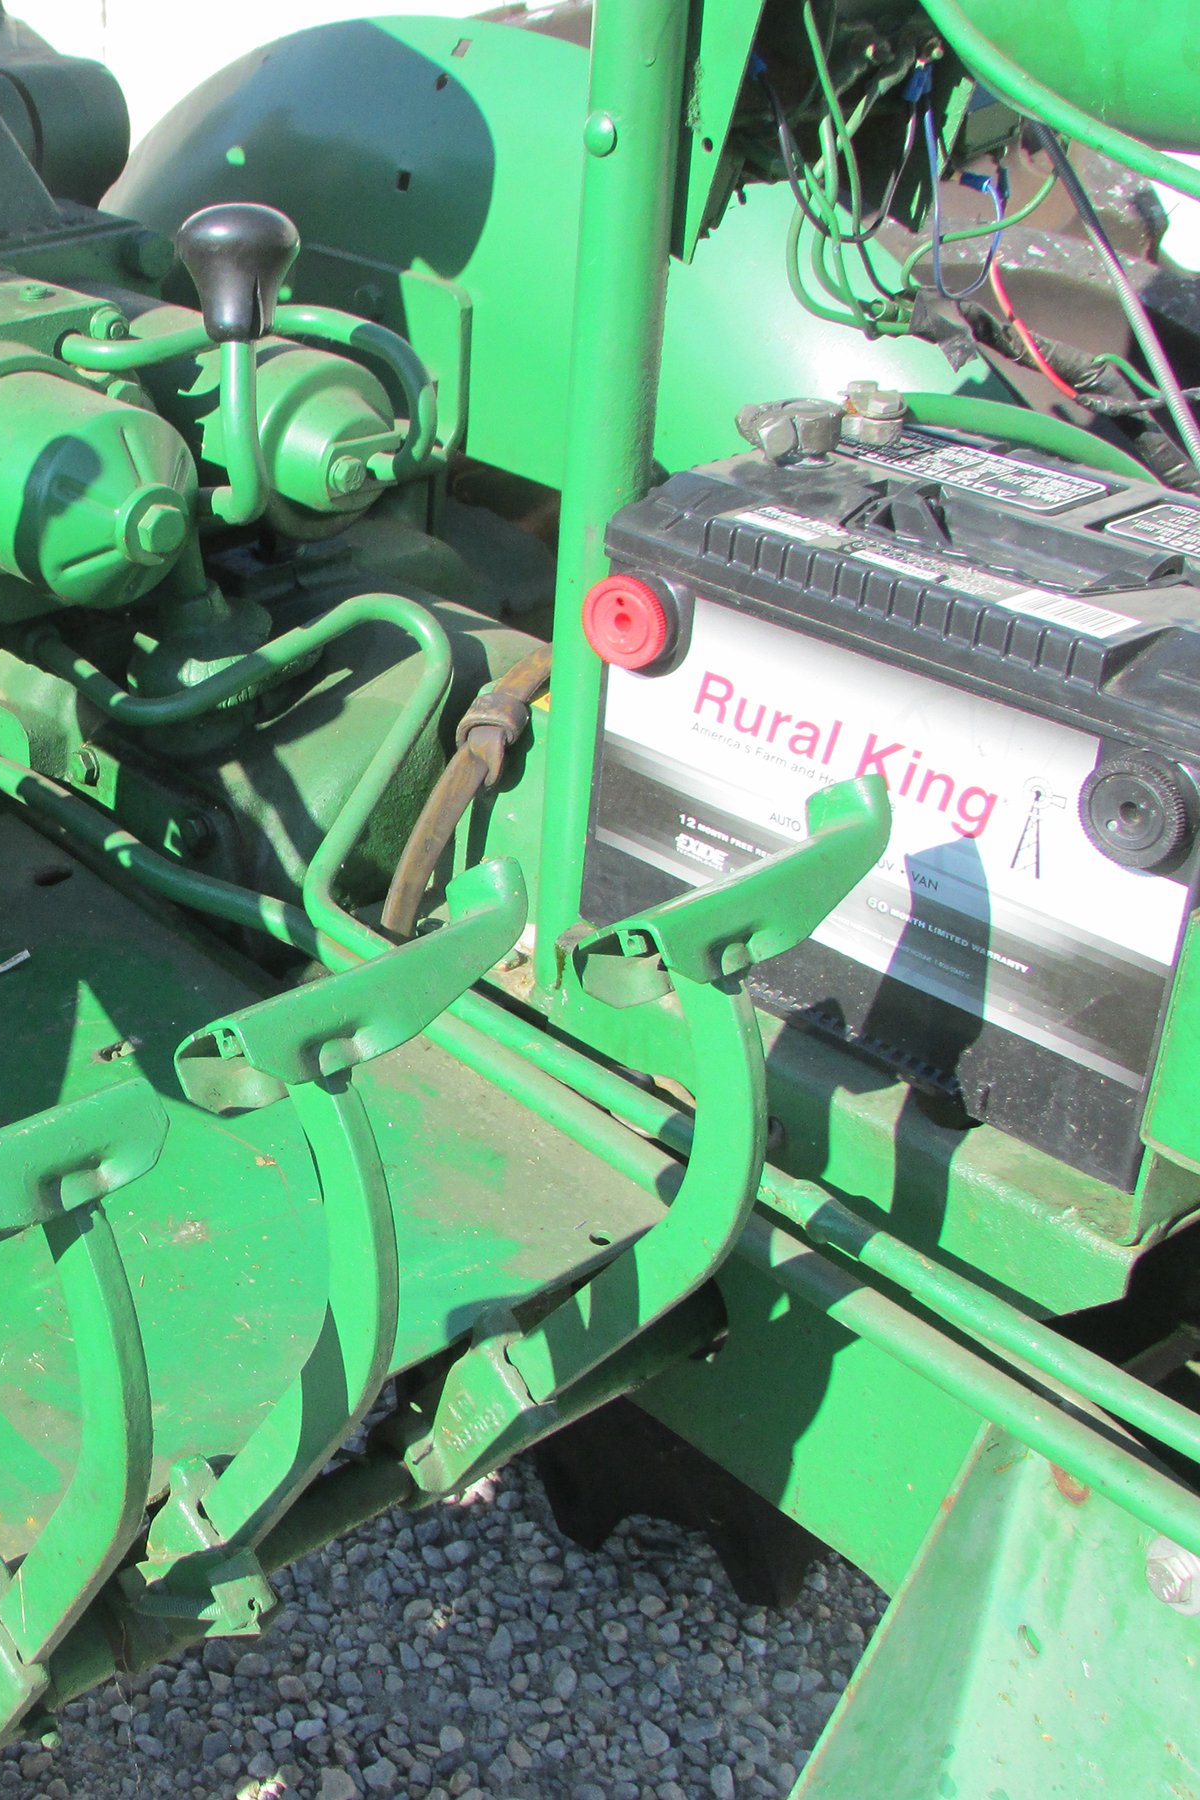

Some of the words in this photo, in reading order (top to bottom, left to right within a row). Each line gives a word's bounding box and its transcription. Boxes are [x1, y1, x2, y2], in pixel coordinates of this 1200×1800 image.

[691, 722, 752, 754] Americas
[755, 747, 787, 768] Farm
[790, 762, 816, 779] and
[693, 671, 843, 765] Rural
[854, 732, 998, 838] King
[679, 813, 697, 830] 12
[697, 823, 730, 842] MONTH
[730, 837, 754, 853] FREE
[769, 812, 801, 832] AUTO
[675, 832, 729, 867] EXIDE
[911, 871, 939, 891] VAN
[866, 896, 889, 913] 60
[890, 908, 927, 929] MONTH
[928, 924, 970, 948] LIMITED
[971, 944, 1031, 974] WARRANTY
